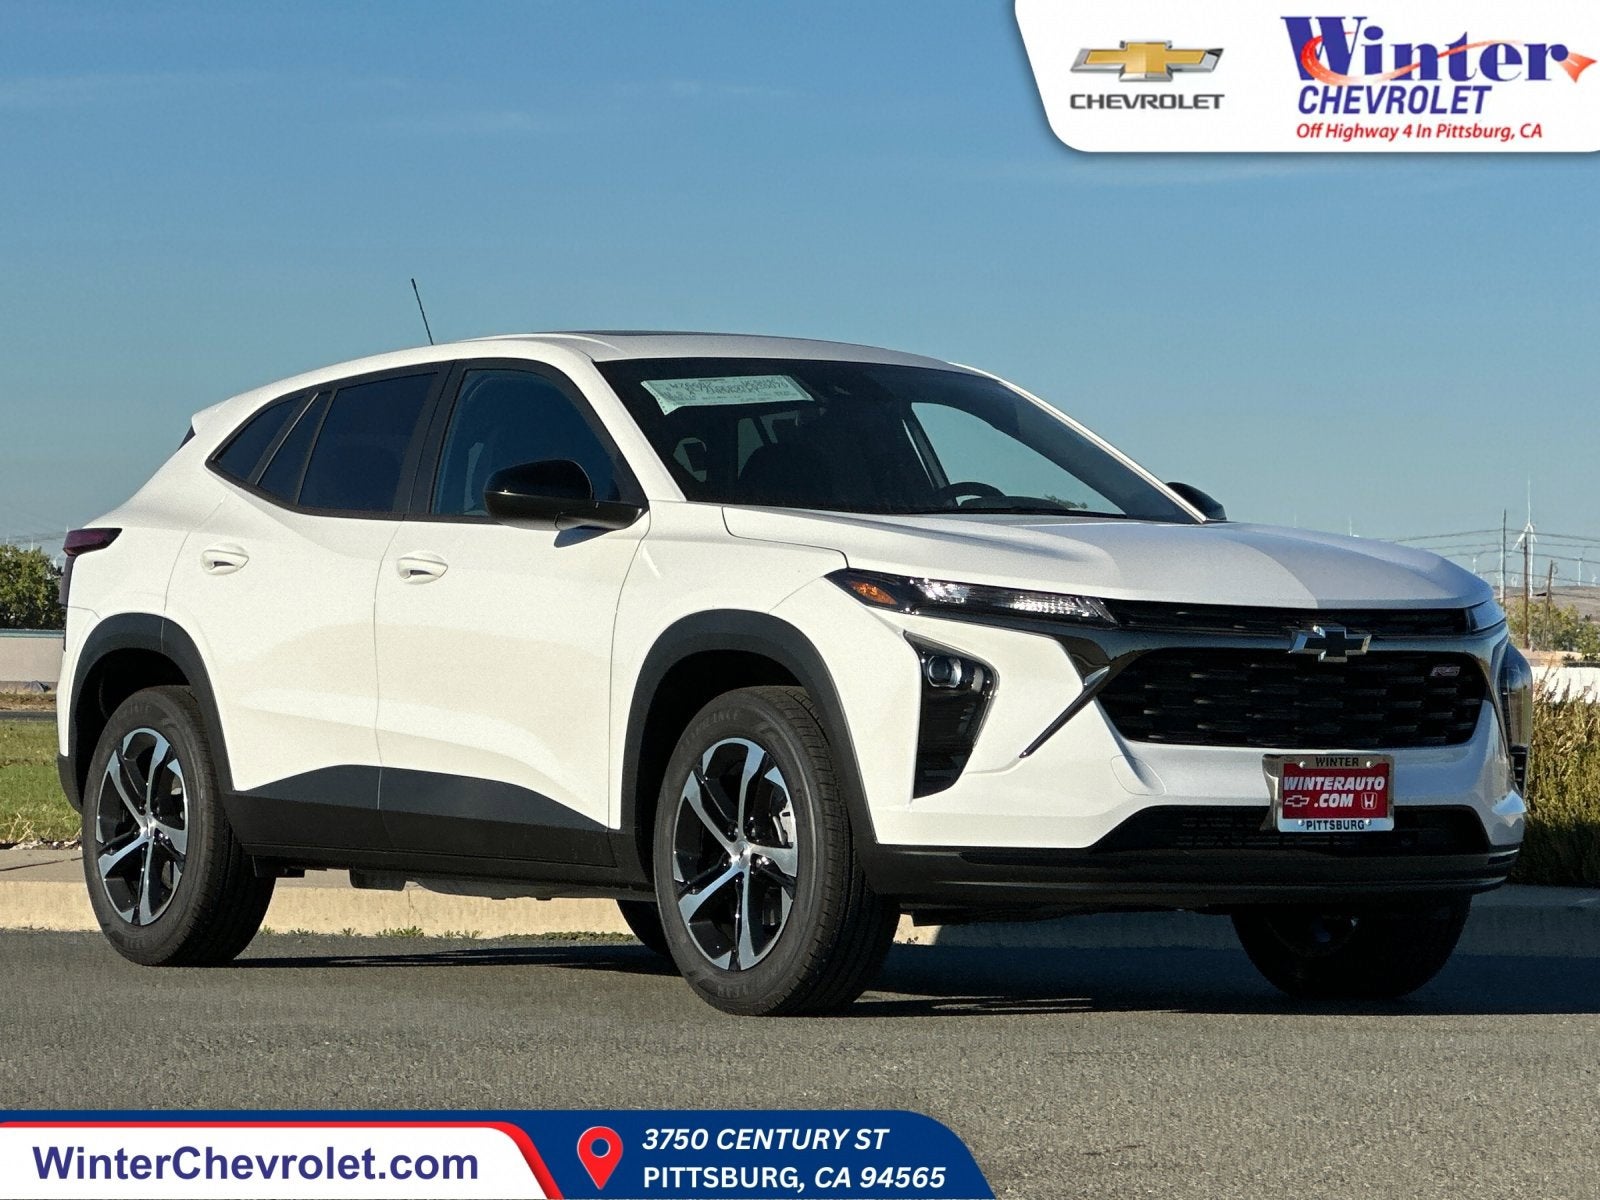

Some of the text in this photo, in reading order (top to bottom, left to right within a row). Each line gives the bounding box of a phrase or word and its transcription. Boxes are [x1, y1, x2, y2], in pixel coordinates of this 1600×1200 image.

[1315, 757, 1359, 767] WINTER
[1283, 776, 1385, 791] WINTERAUTO
[1313, 793, 1354, 808] .COM
[1306, 820, 1365, 831] PITTSBURG
